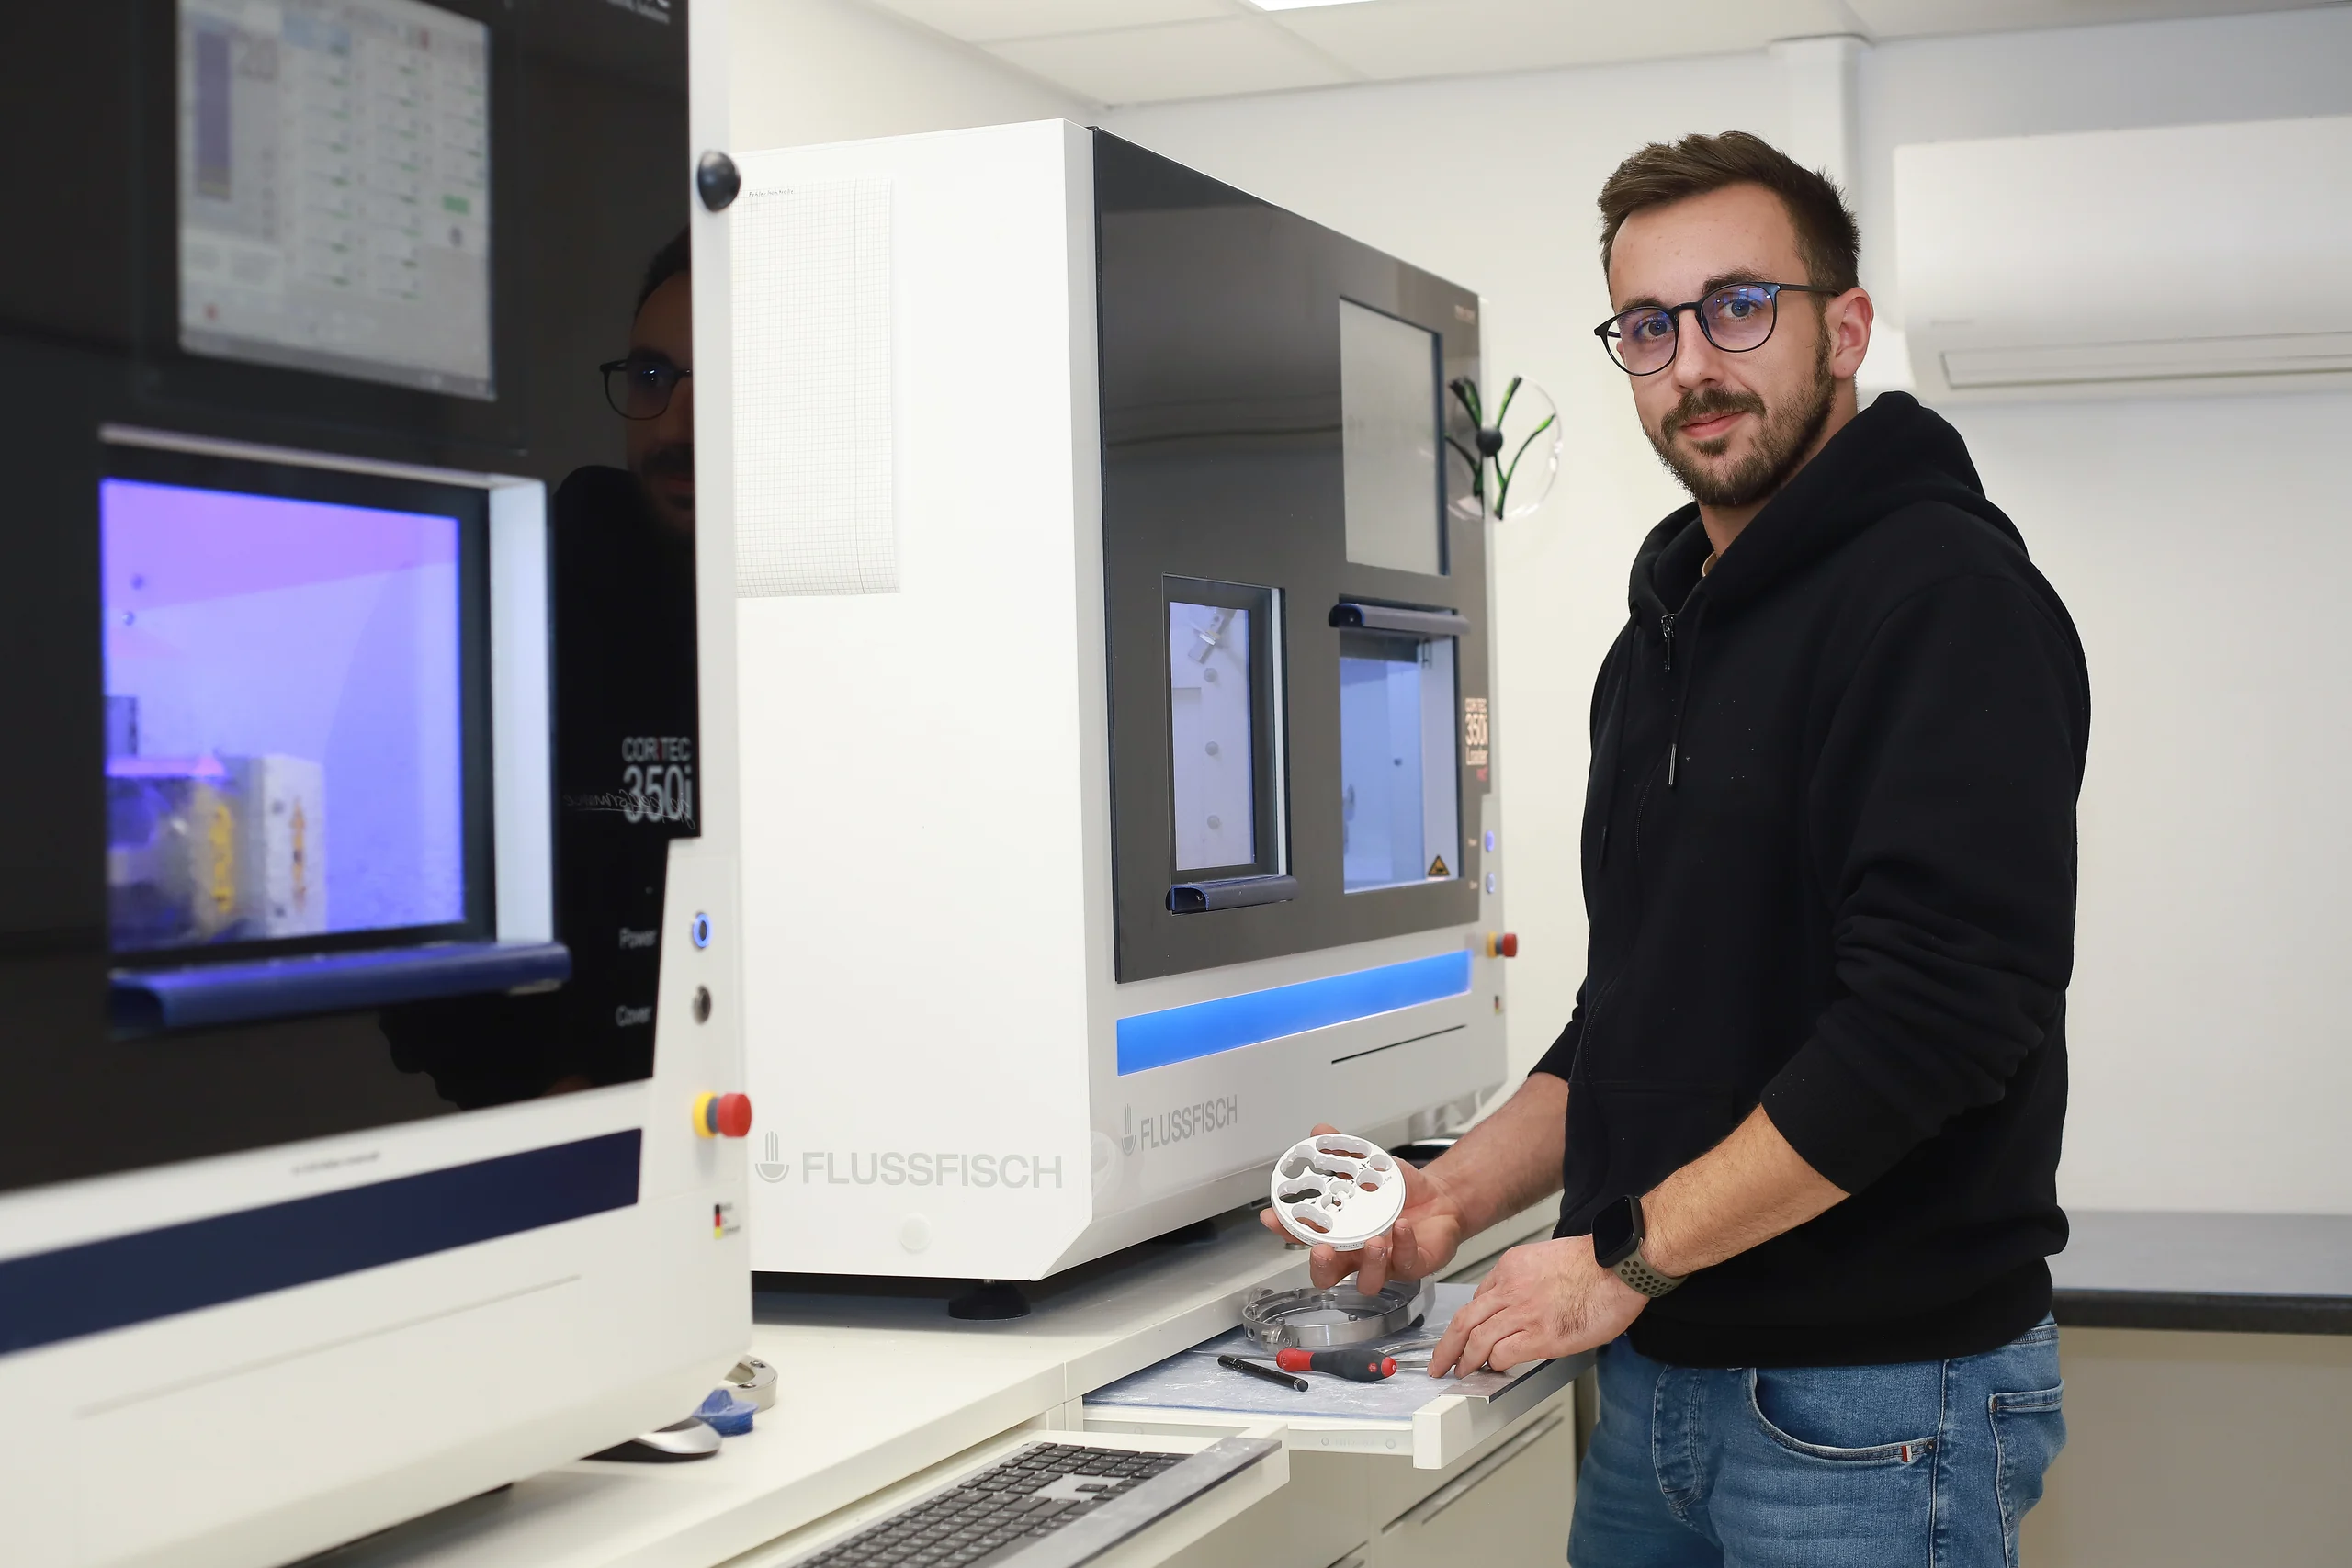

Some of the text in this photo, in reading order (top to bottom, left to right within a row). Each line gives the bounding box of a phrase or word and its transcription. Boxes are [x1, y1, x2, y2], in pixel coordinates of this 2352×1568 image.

[623, 764, 693, 824] 350i
[618, 927, 658, 950] Power
[1140, 1094, 1238, 1152] FLUSSFISCH
[801, 1151, 1063, 1189] FLUSSFISCH
